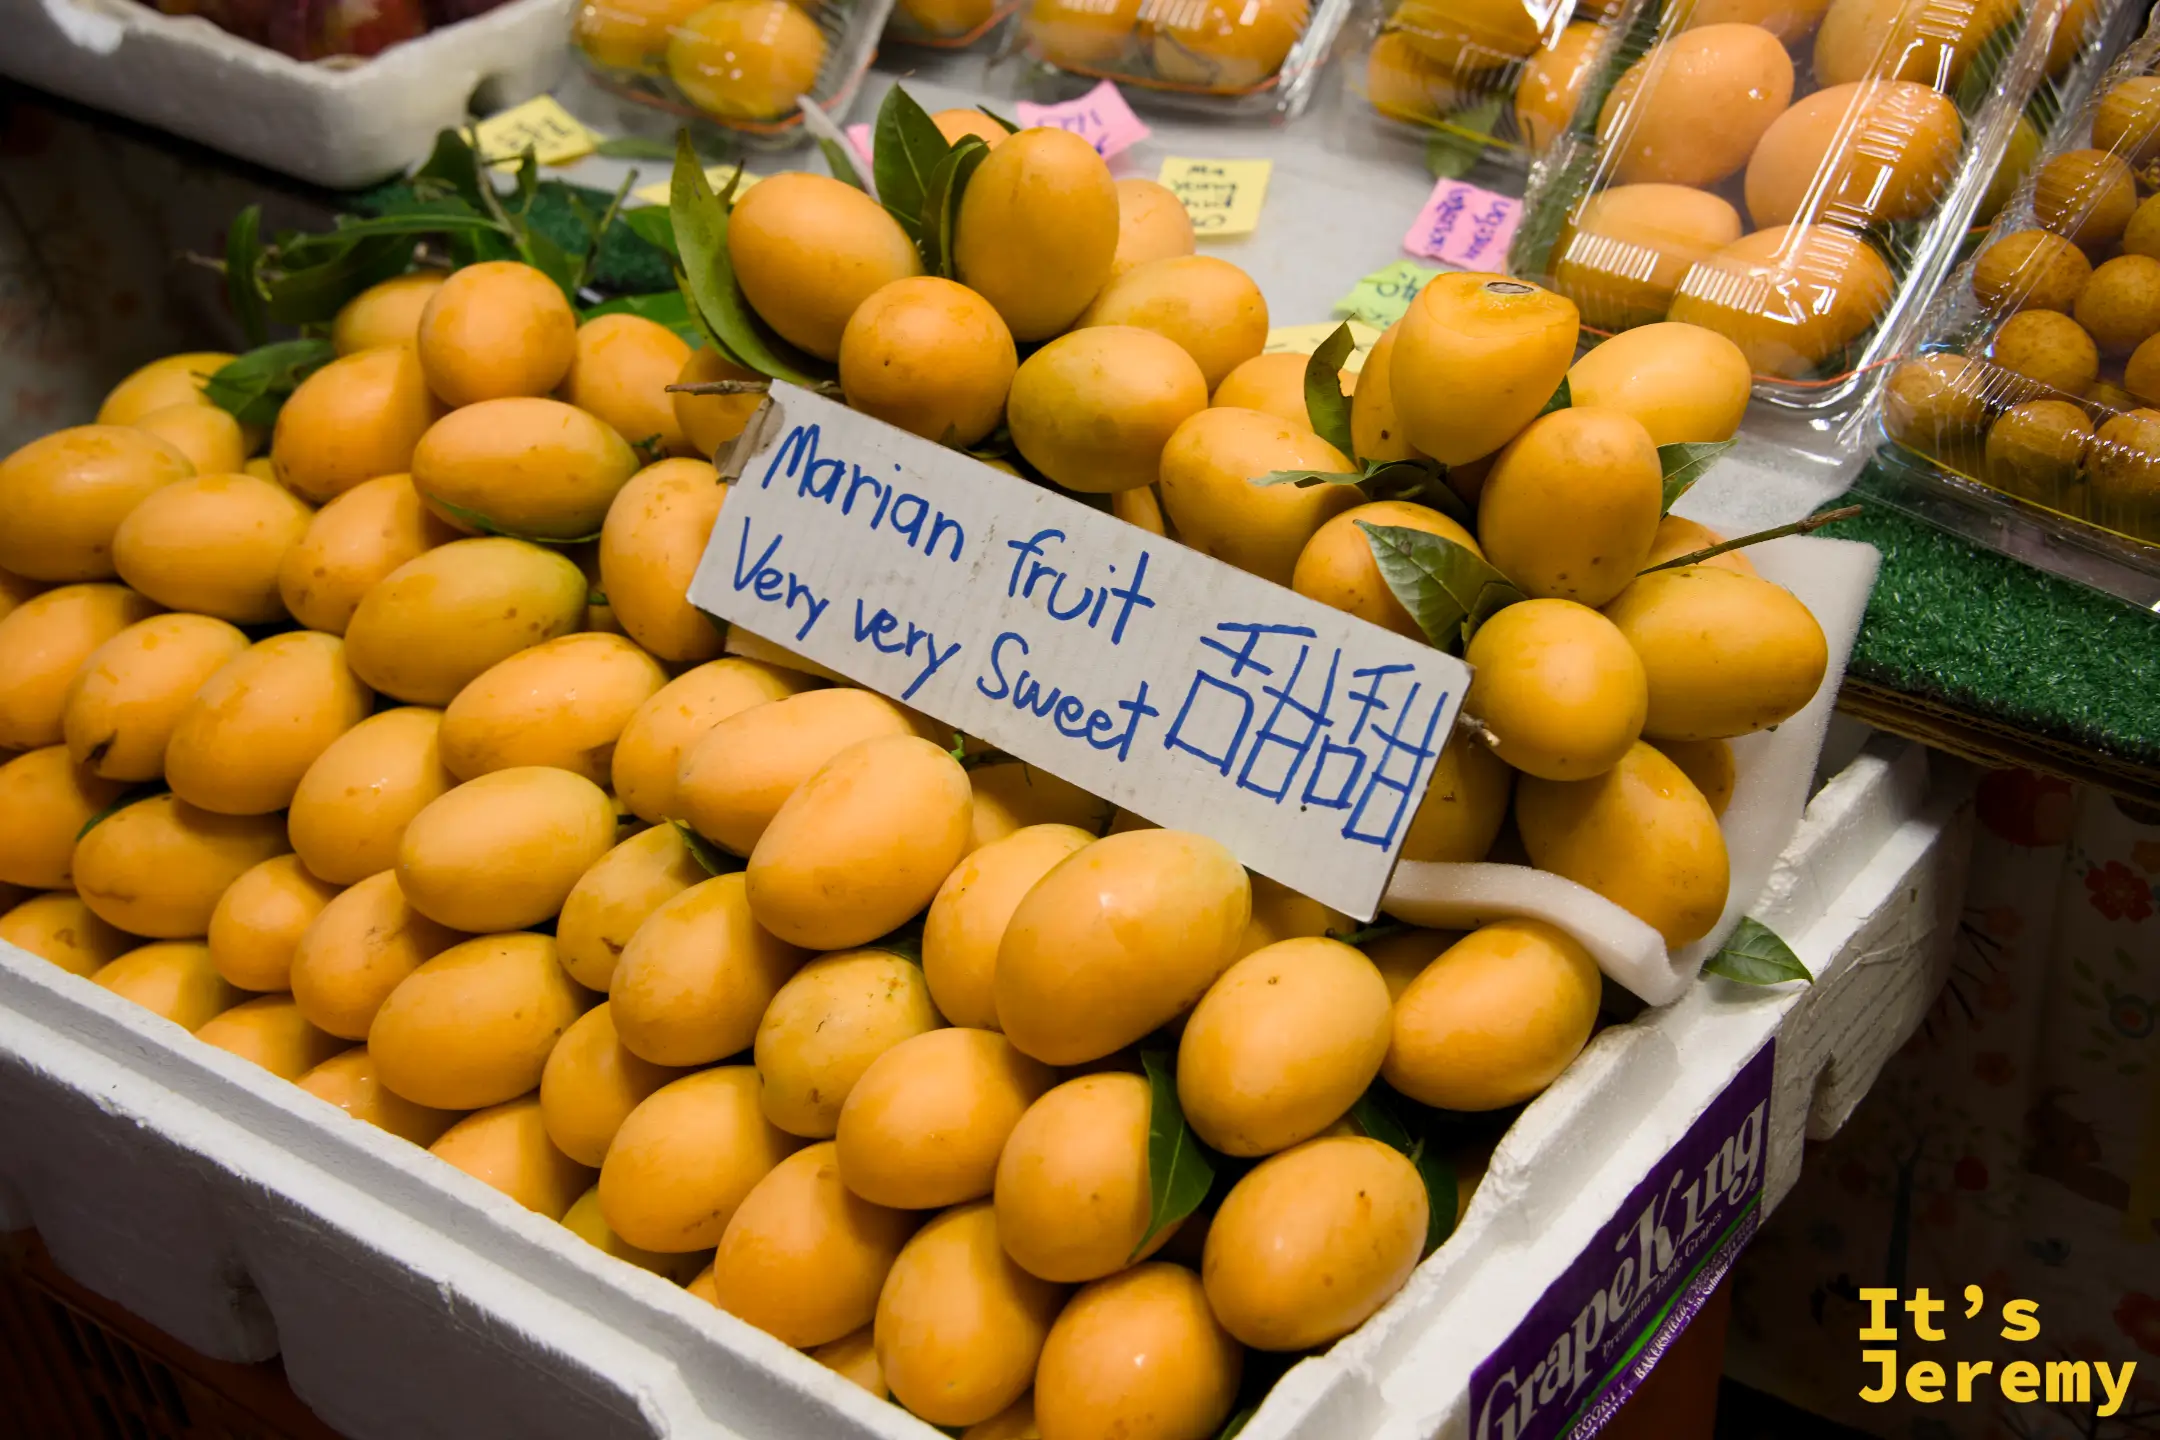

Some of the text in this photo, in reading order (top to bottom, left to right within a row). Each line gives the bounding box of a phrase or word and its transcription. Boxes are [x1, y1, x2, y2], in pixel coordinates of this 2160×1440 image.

[733, 516, 1159, 762] Very very Sweet
[761, 424, 1155, 645] Marian fruit
[1685, 1209, 1722, 1257] Grapes
